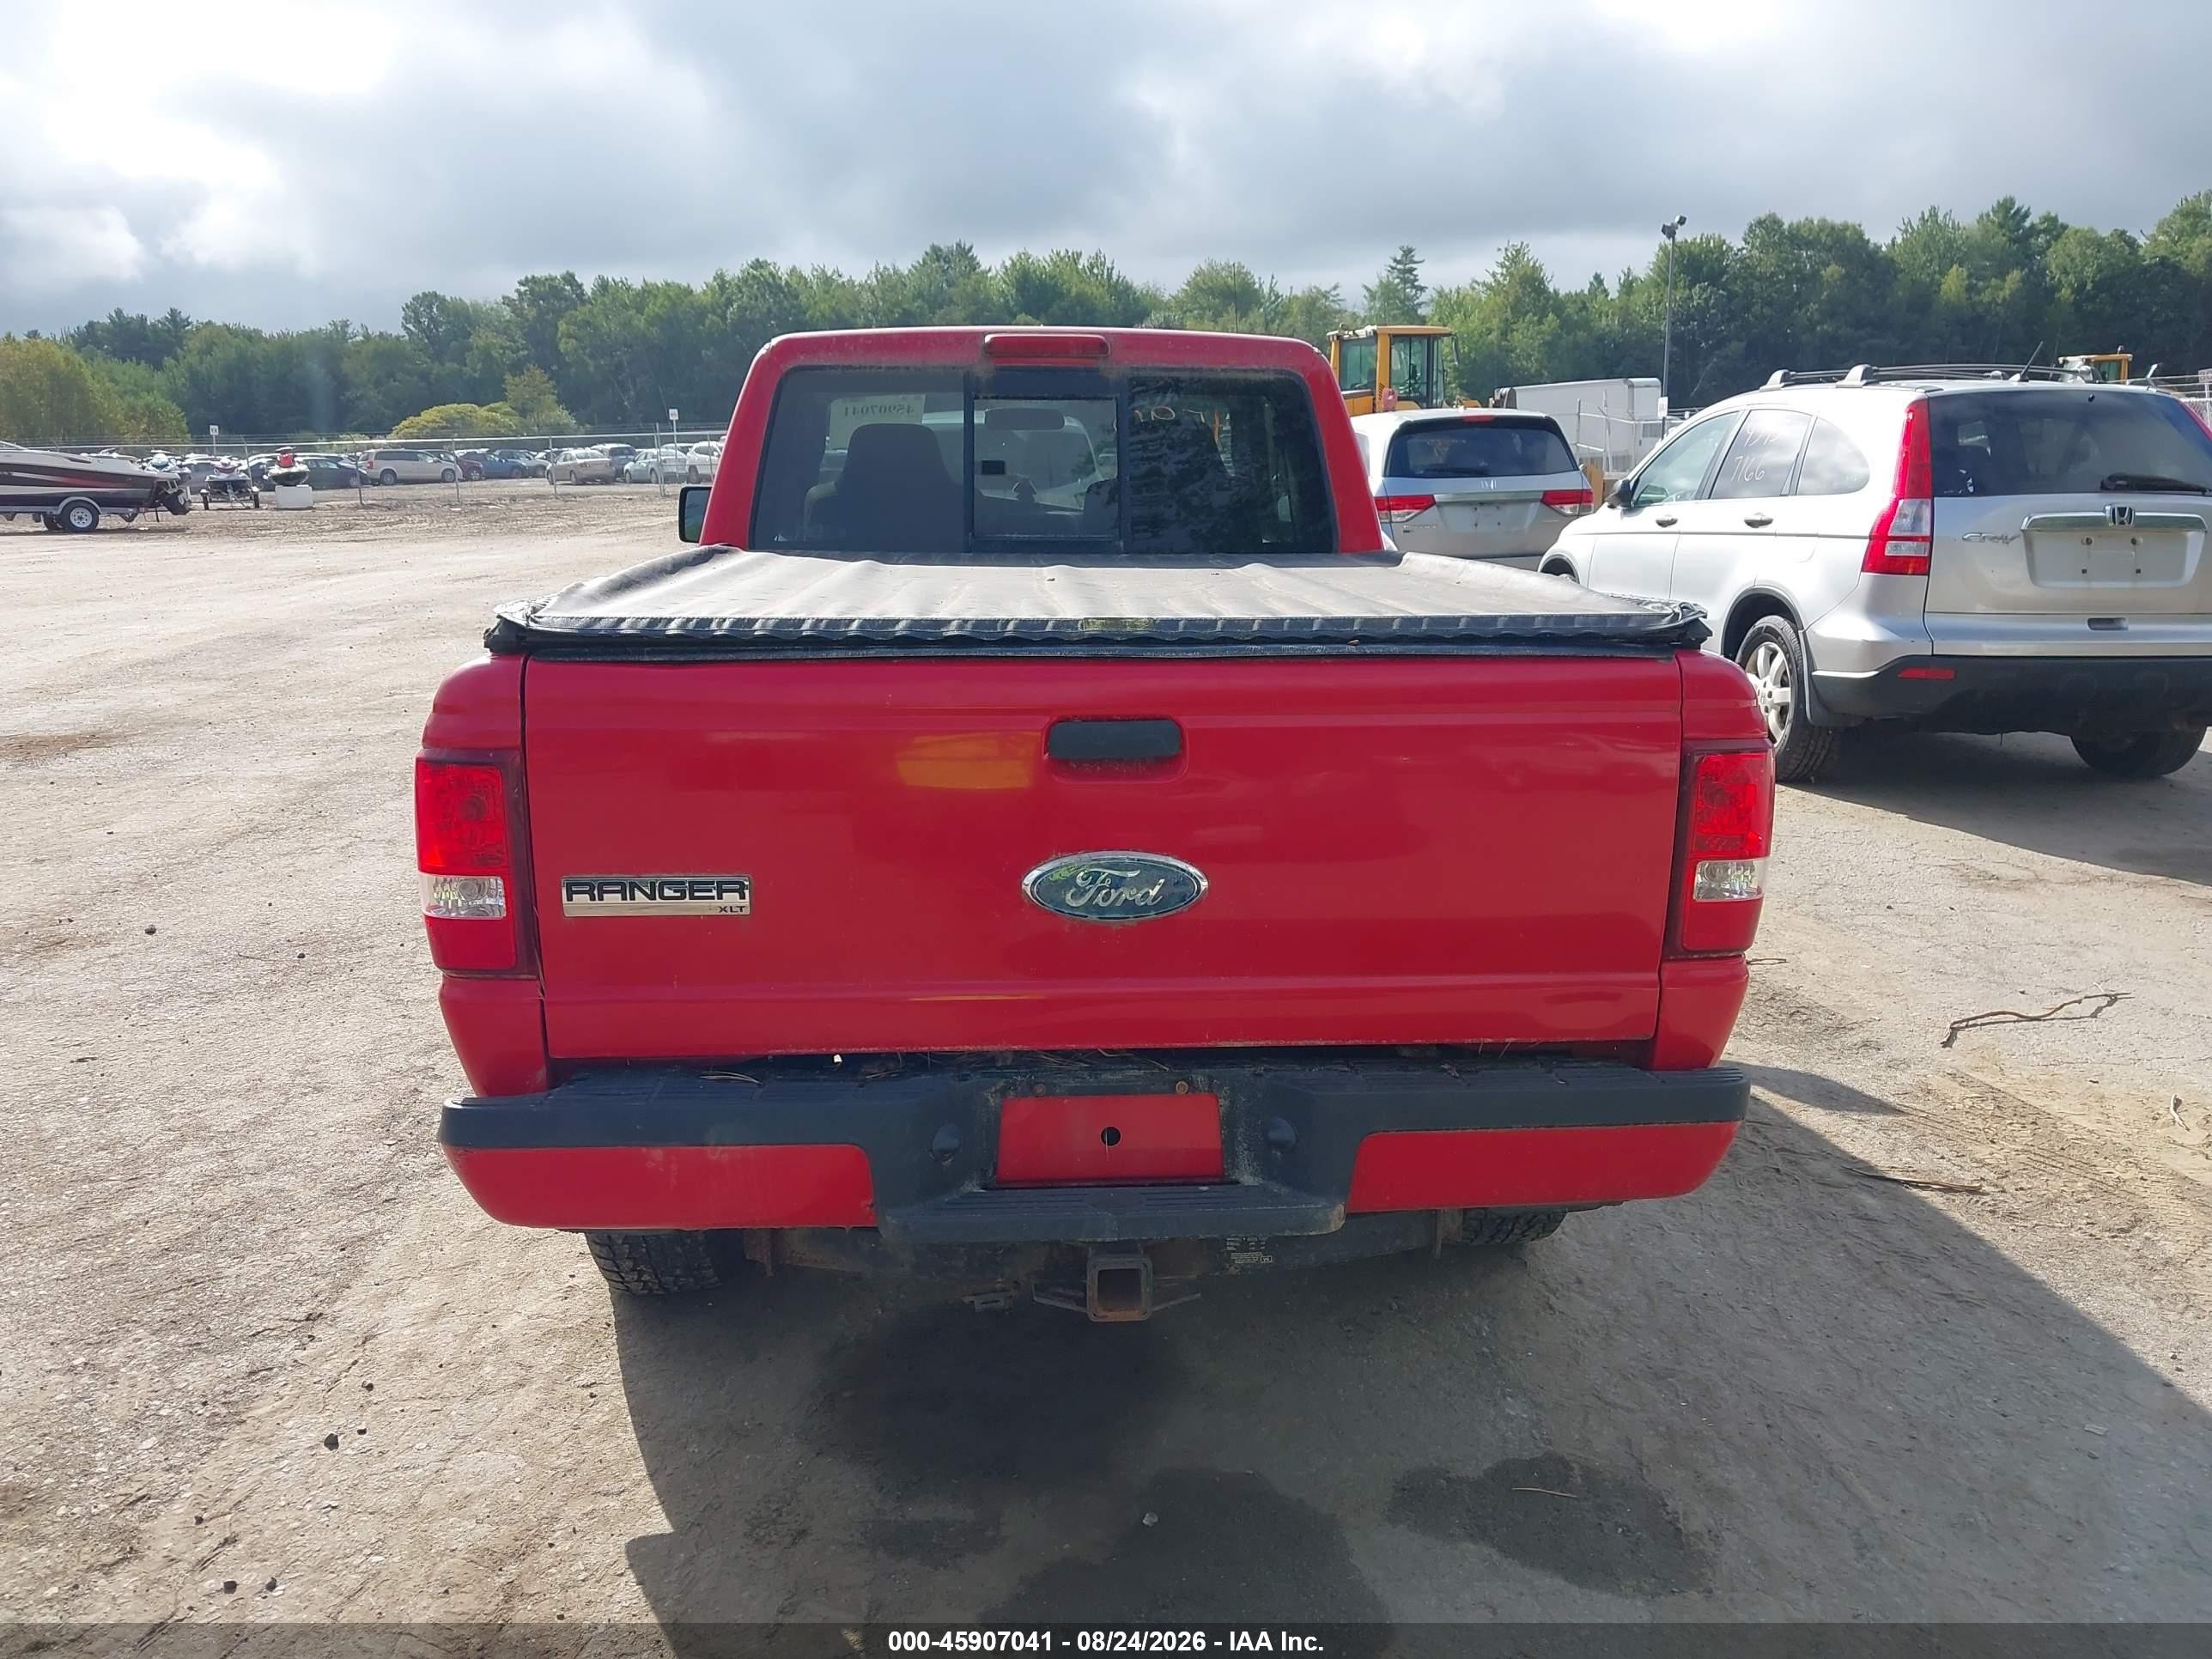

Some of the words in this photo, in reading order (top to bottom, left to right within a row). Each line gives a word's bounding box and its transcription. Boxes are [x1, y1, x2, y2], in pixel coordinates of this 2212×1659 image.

[1731, 455, 1765, 482] 7166
[566, 881, 746, 902] RANGER
[1066, 867, 1165, 907] Ford
